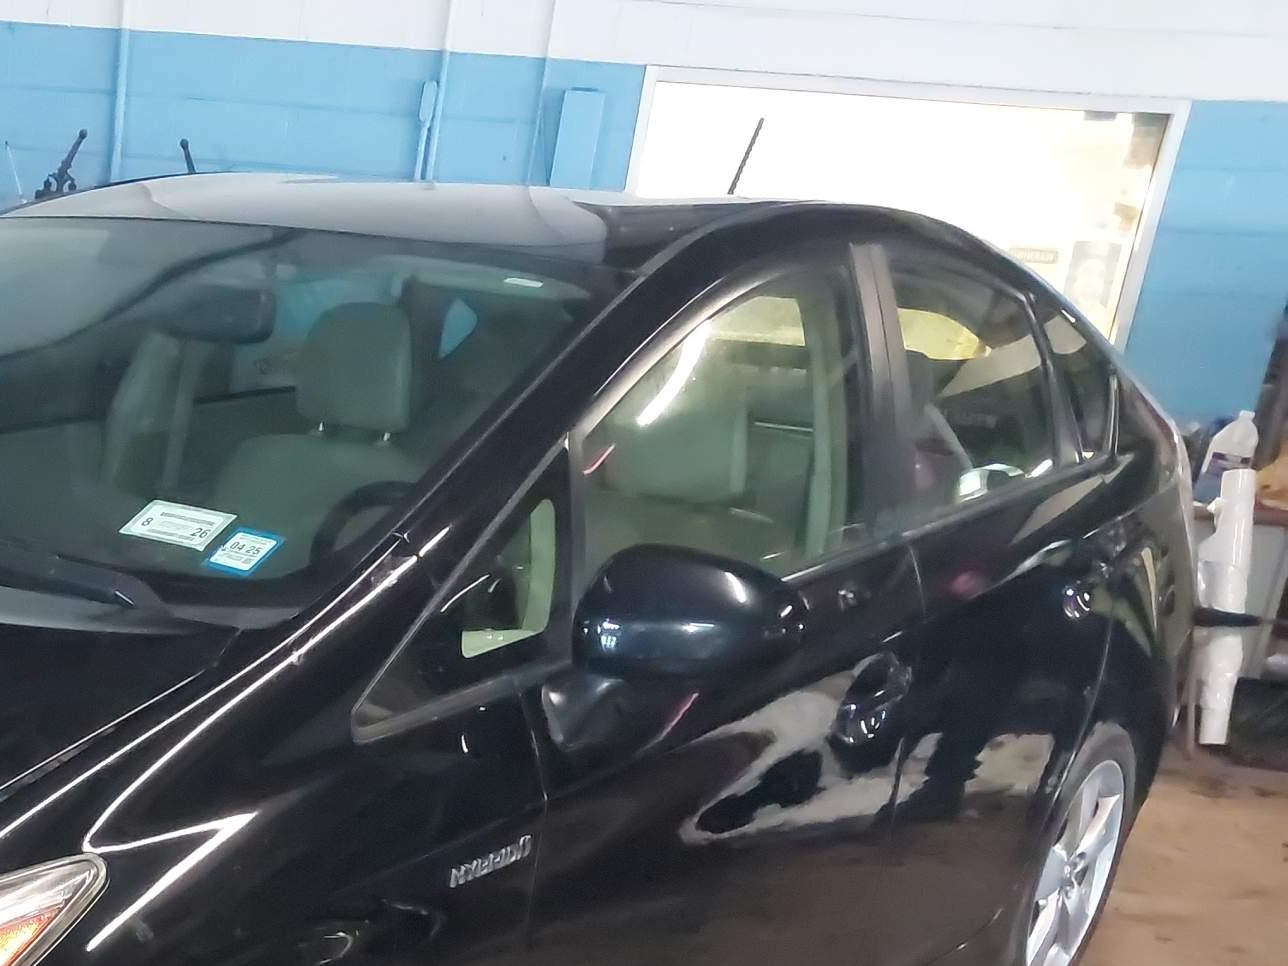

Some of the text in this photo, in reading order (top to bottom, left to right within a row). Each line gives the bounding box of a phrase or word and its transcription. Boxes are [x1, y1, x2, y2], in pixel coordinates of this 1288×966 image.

[141, 517, 154, 527] 8
[190, 527, 210, 539] 26
[229, 541, 263, 556] 04 25
